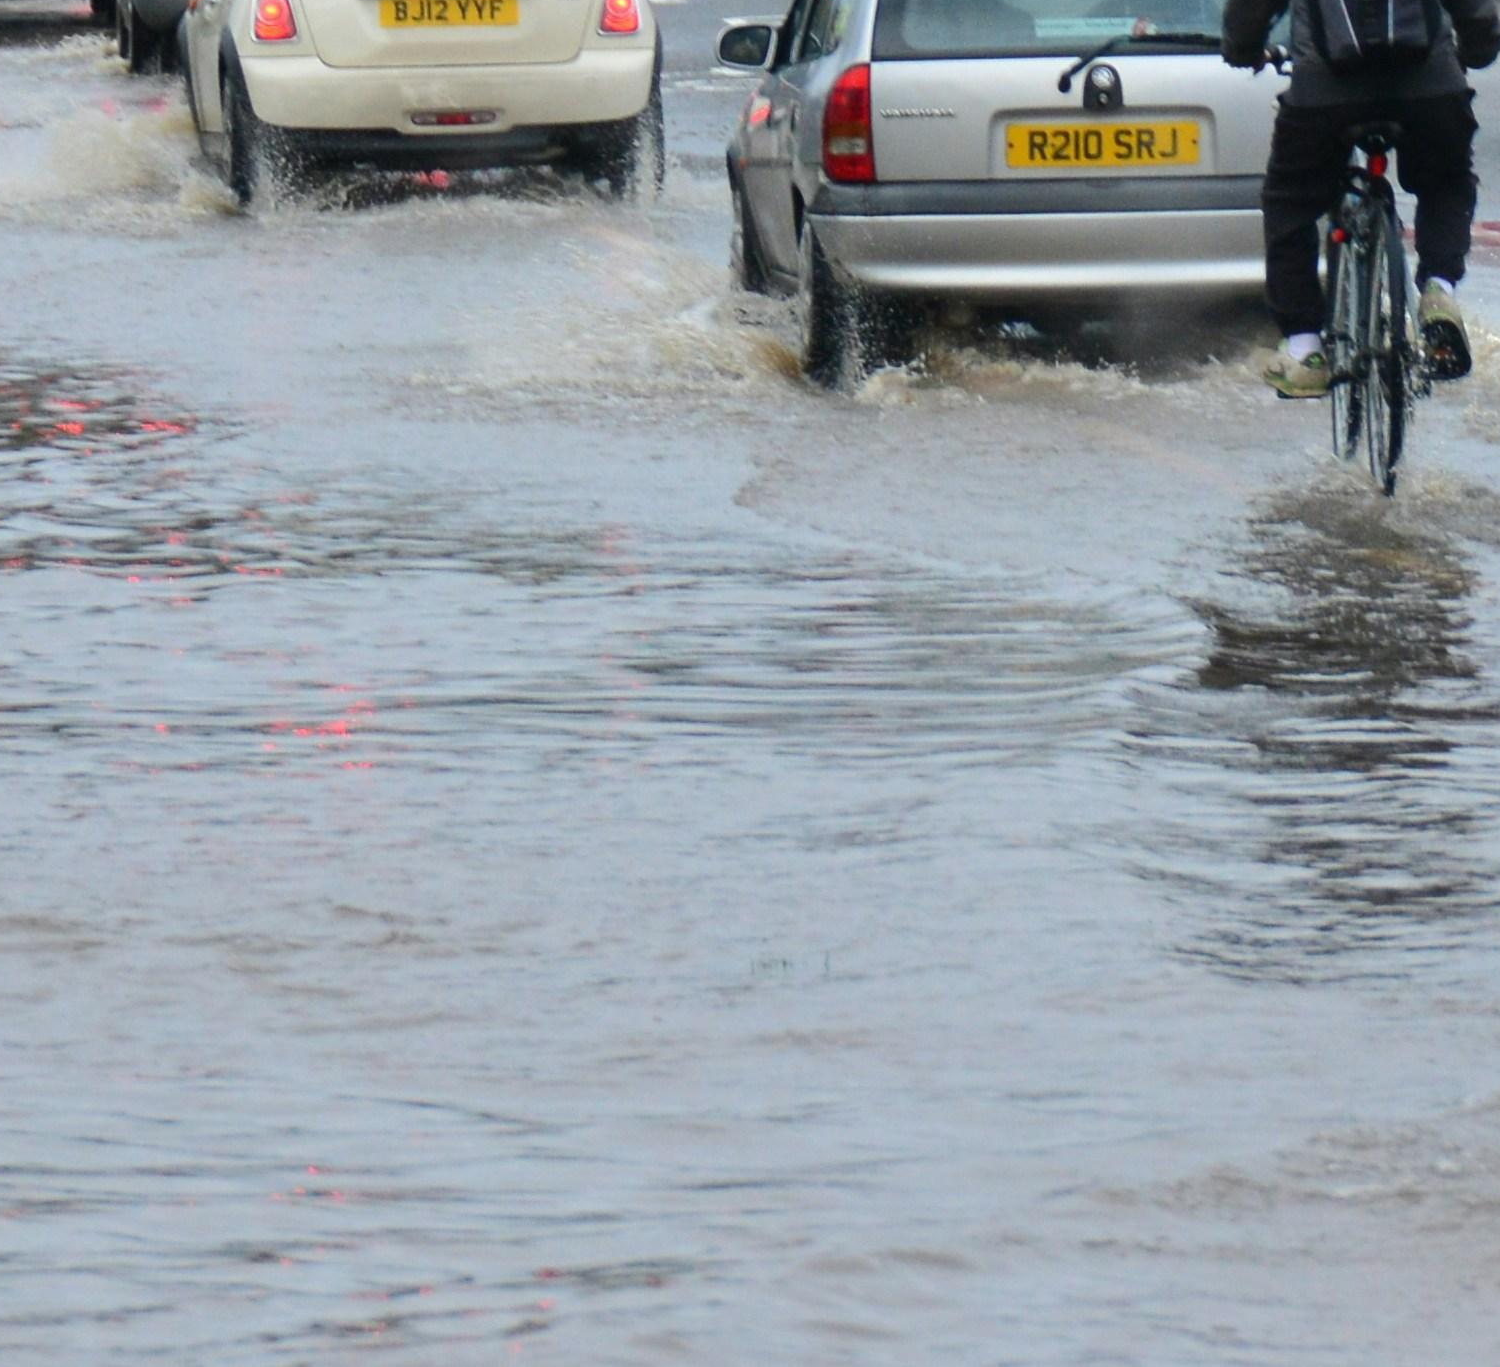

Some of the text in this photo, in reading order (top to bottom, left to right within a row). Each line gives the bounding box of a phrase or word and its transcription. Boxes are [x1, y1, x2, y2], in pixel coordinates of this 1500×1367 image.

[393, 0, 449, 22] BJ12
[1028, 128, 1179, 161] R210 SRJ
